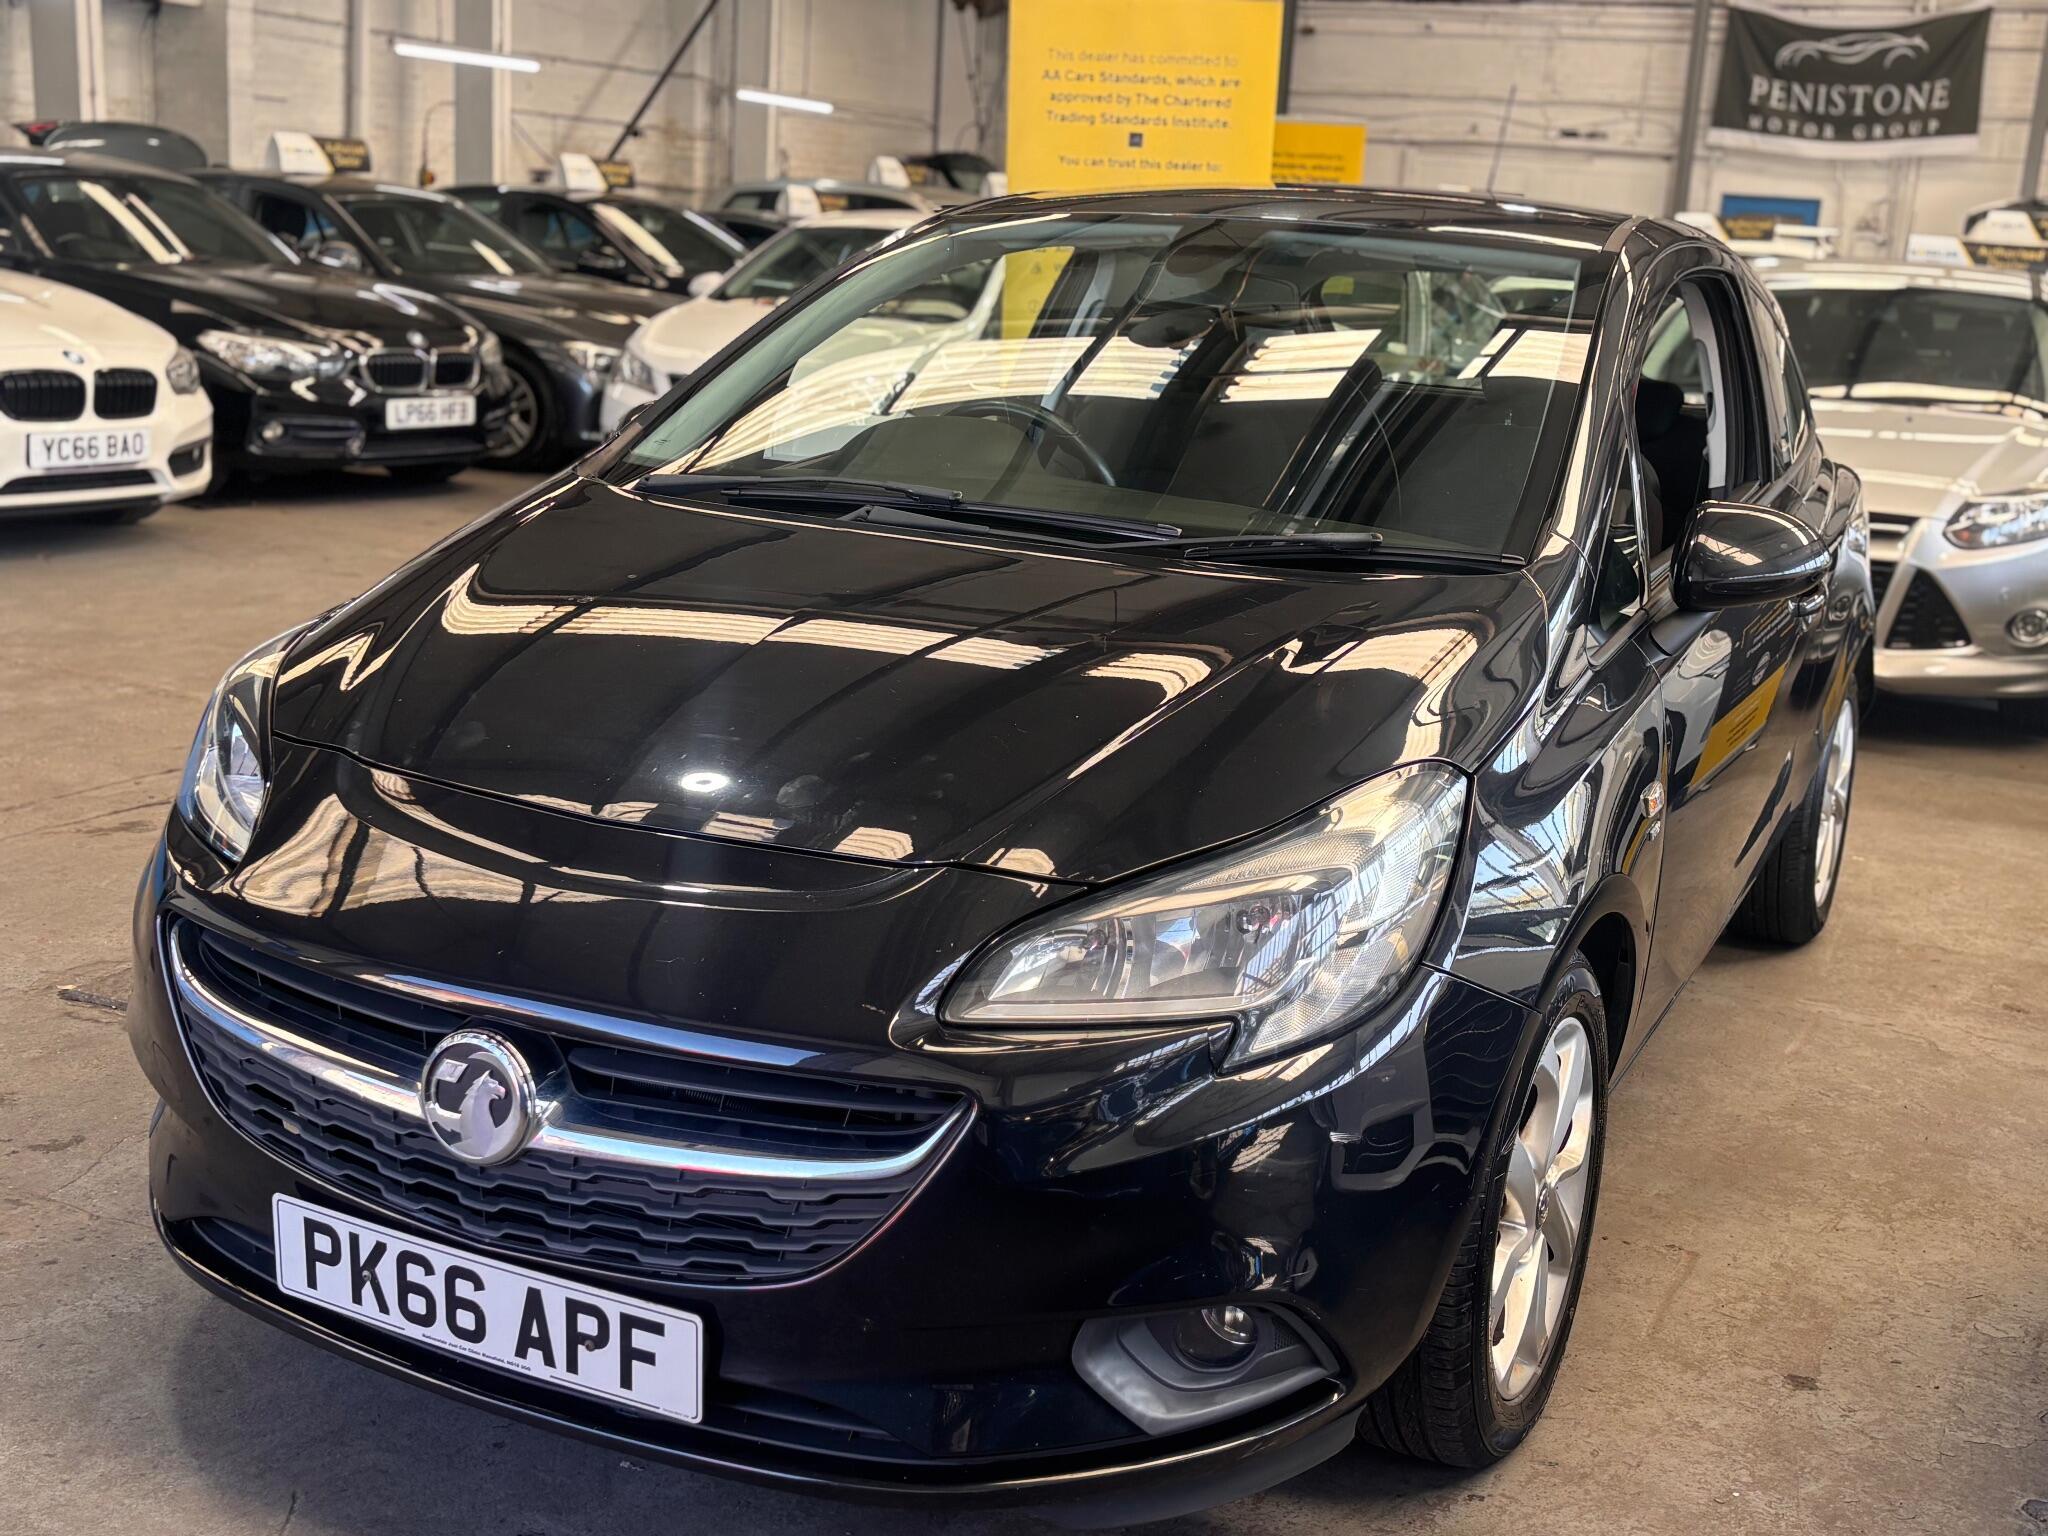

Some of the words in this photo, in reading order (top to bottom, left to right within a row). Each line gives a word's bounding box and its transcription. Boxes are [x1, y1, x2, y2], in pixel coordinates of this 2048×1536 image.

[1047, 48, 1075, 62] This
[1079, 50, 1119, 64] dealer
[1123, 52, 1145, 64] has
[1149, 54, 1220, 67] committed
[1042, 69, 1061, 81] AA
[1064, 69, 1095, 83] Cars
[1099, 71, 1172, 87] Standards,
[1177, 75, 1216, 88] which
[1221, 78, 1242, 89] are
[1050, 93, 1113, 107] approved
[1116, 94, 1131, 108] by
[1135, 93, 1159, 106] The
[1163, 95, 1232, 109] Chartered
[1750, 73, 1951, 117] PENISTONE
[1046, 109, 1097, 126] Trading
[1100, 112, 1169, 127] Standards
[1748, 114, 1836, 140] MOTOR
[1852, 117, 1941, 141] GROUP
[1058, 154, 1080, 167] You
[1083, 157, 1105, 168] can
[1107, 157, 1137, 170] trust
[1139, 159, 1162, 171] this
[1165, 160, 1204, 172] dealer
[42, 436, 99, 462] YC66
[303, 1216, 487, 1345] PK66
[514, 1286, 665, 1391] APF
